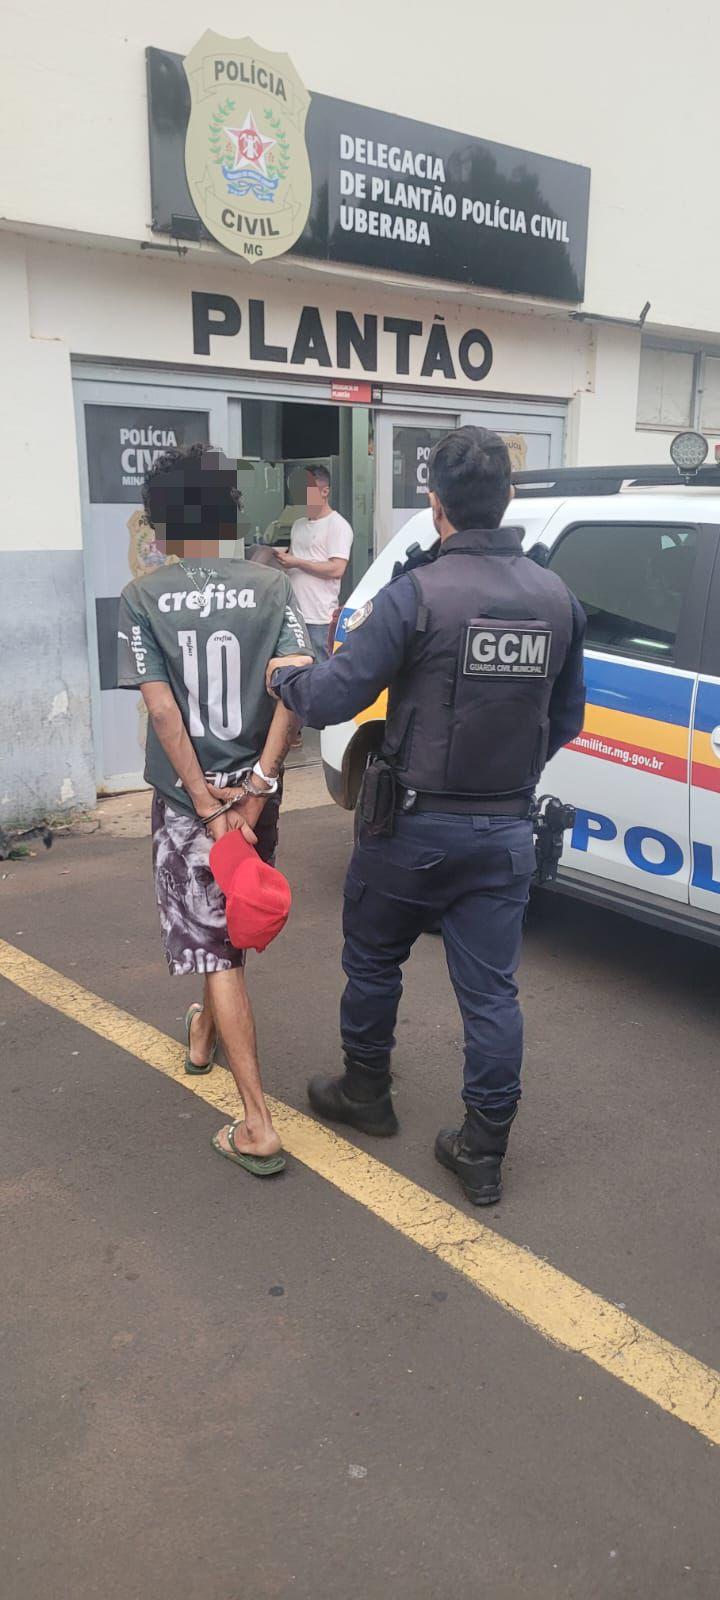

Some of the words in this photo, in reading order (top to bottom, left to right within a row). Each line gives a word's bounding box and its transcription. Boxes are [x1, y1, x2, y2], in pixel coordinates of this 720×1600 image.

[213, 59, 288, 101] POLÍCIA
[339, 134, 446, 183] DELEGACIA
[221, 209, 280, 237] CIVIL
[339, 170, 368, 199] DE
[371, 180, 457, 216] PLANTÃO
[461, 199, 527, 234] POLÍCIA
[530, 215, 570, 243] CIVIL
[340, 205, 431, 247] UBERABA
[243, 242, 263, 257] MG
[191, 291, 494, 382] PLANTÃO
[119, 426, 177, 447] POLÍCIA
[121, 448, 167, 474] CIV
[157, 583, 257, 618] crefisa
[131, 625, 148, 675] crefisa
[472, 632, 546, 664] GCM
[469, 663, 496, 671] GUARDA
[496, 664, 512, 672] CIVIL
[177, 630, 242, 741] 10
[570, 736, 664, 770] iamilitar.mg.gov.br
